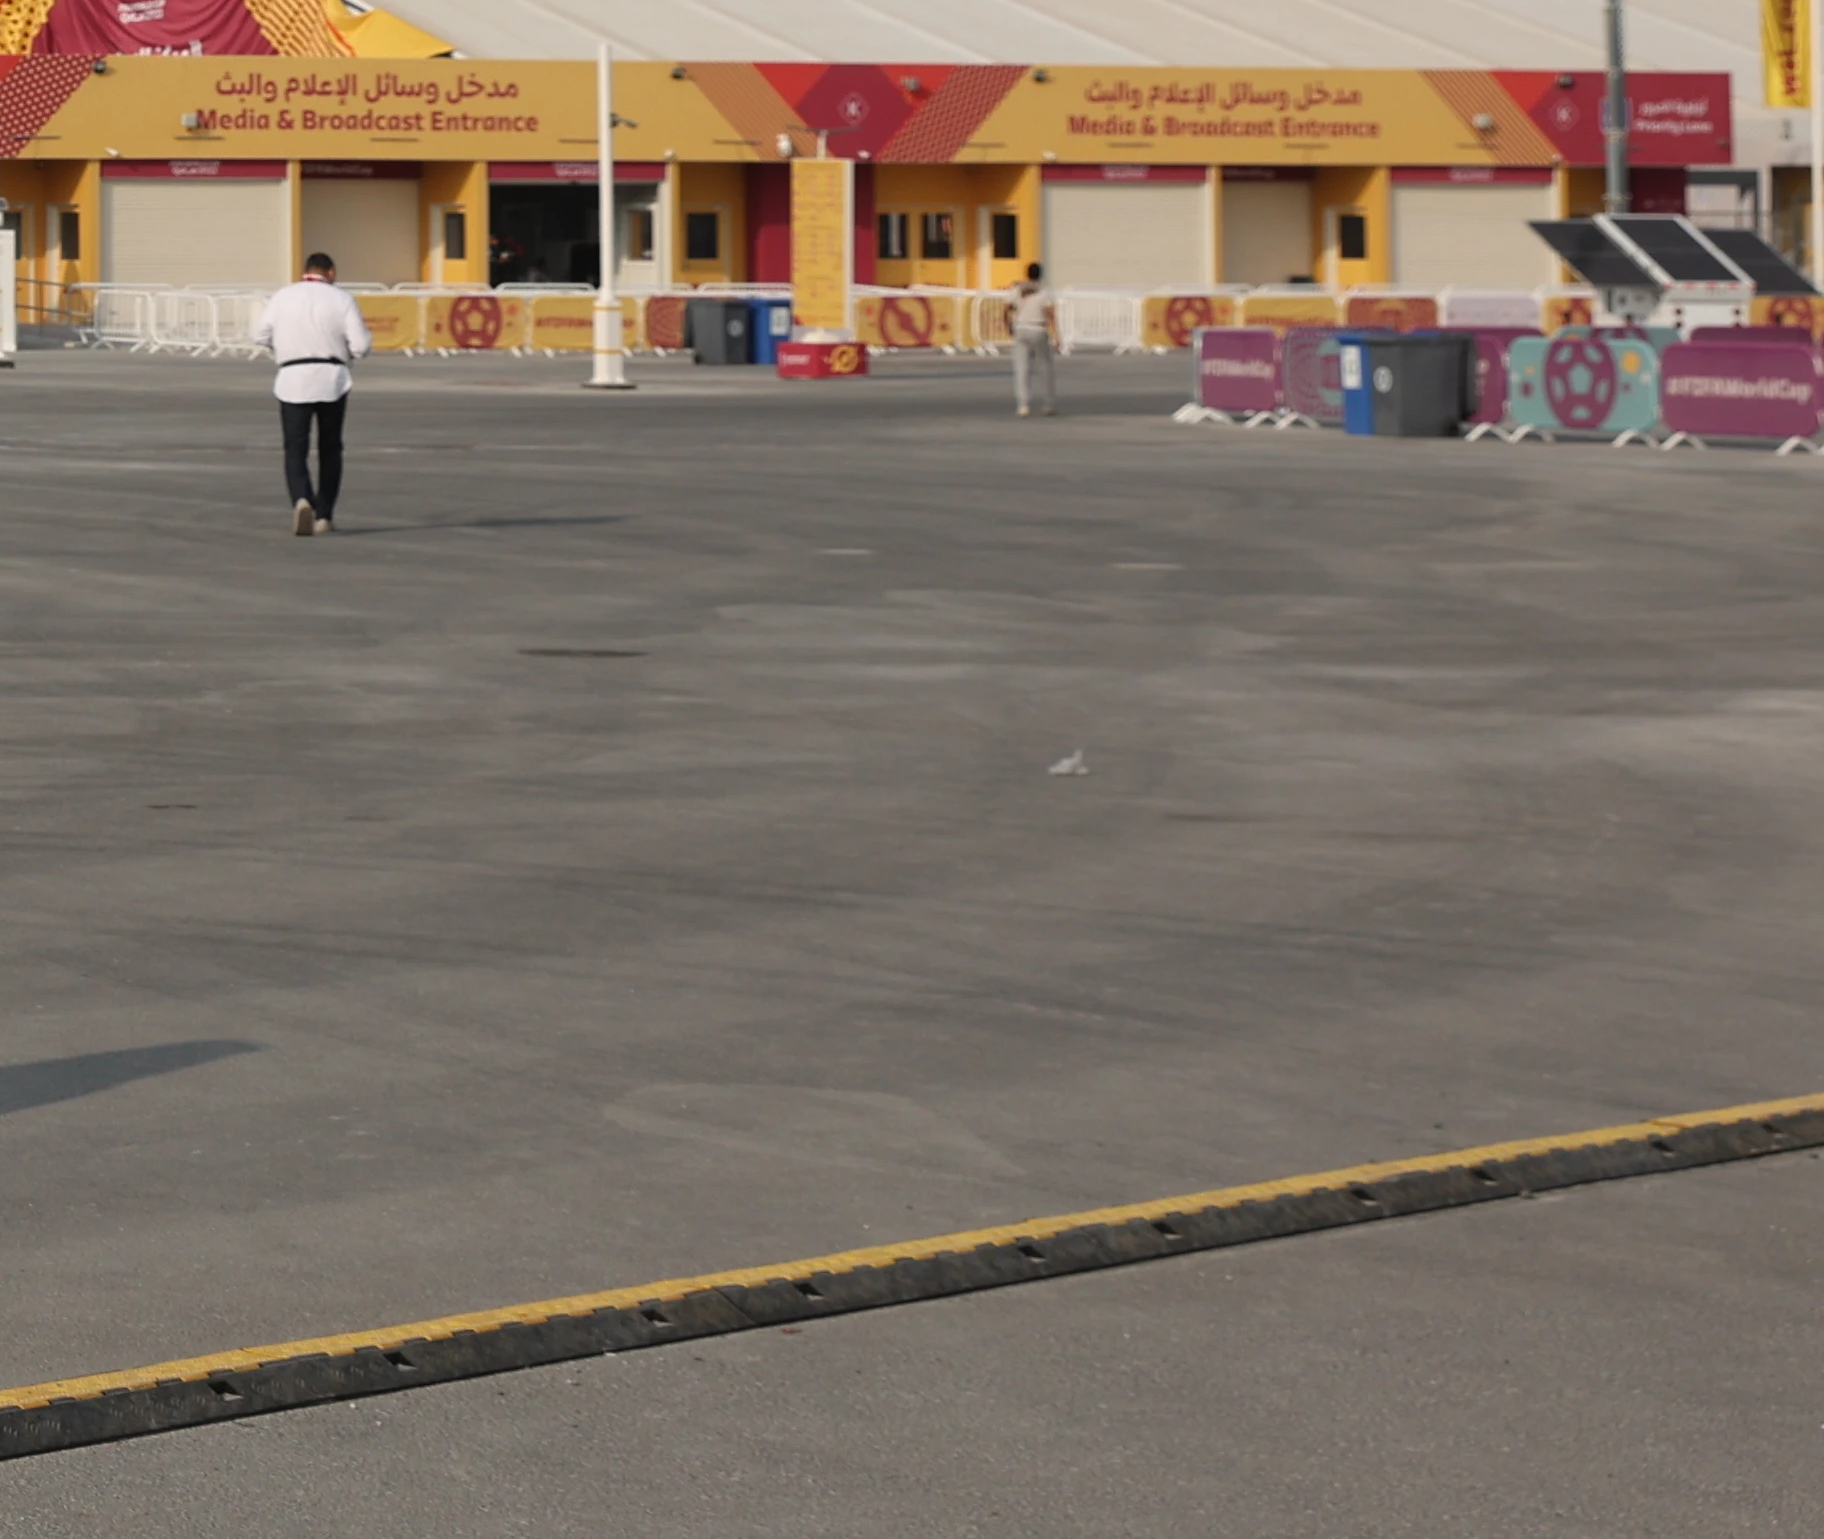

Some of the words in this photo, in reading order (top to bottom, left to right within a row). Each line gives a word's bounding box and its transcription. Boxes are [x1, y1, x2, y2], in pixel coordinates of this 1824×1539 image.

[215, 71, 277, 103] والبث
[284, 72, 357, 106] الإعلام
[364, 72, 439, 104] وسائل
[446, 73, 519, 104] مدخل
[196, 109, 270, 130] Media
[277, 110, 295, 130] &
[302, 110, 425, 131] Broadcast
[432, 111, 539, 132] Entrance
[1068, 115, 1135, 136] Media
[1141, 117, 1157, 136] &
[1162, 116, 1276, 137] Broadcast
[1280, 117, 1381, 138] Entrance
